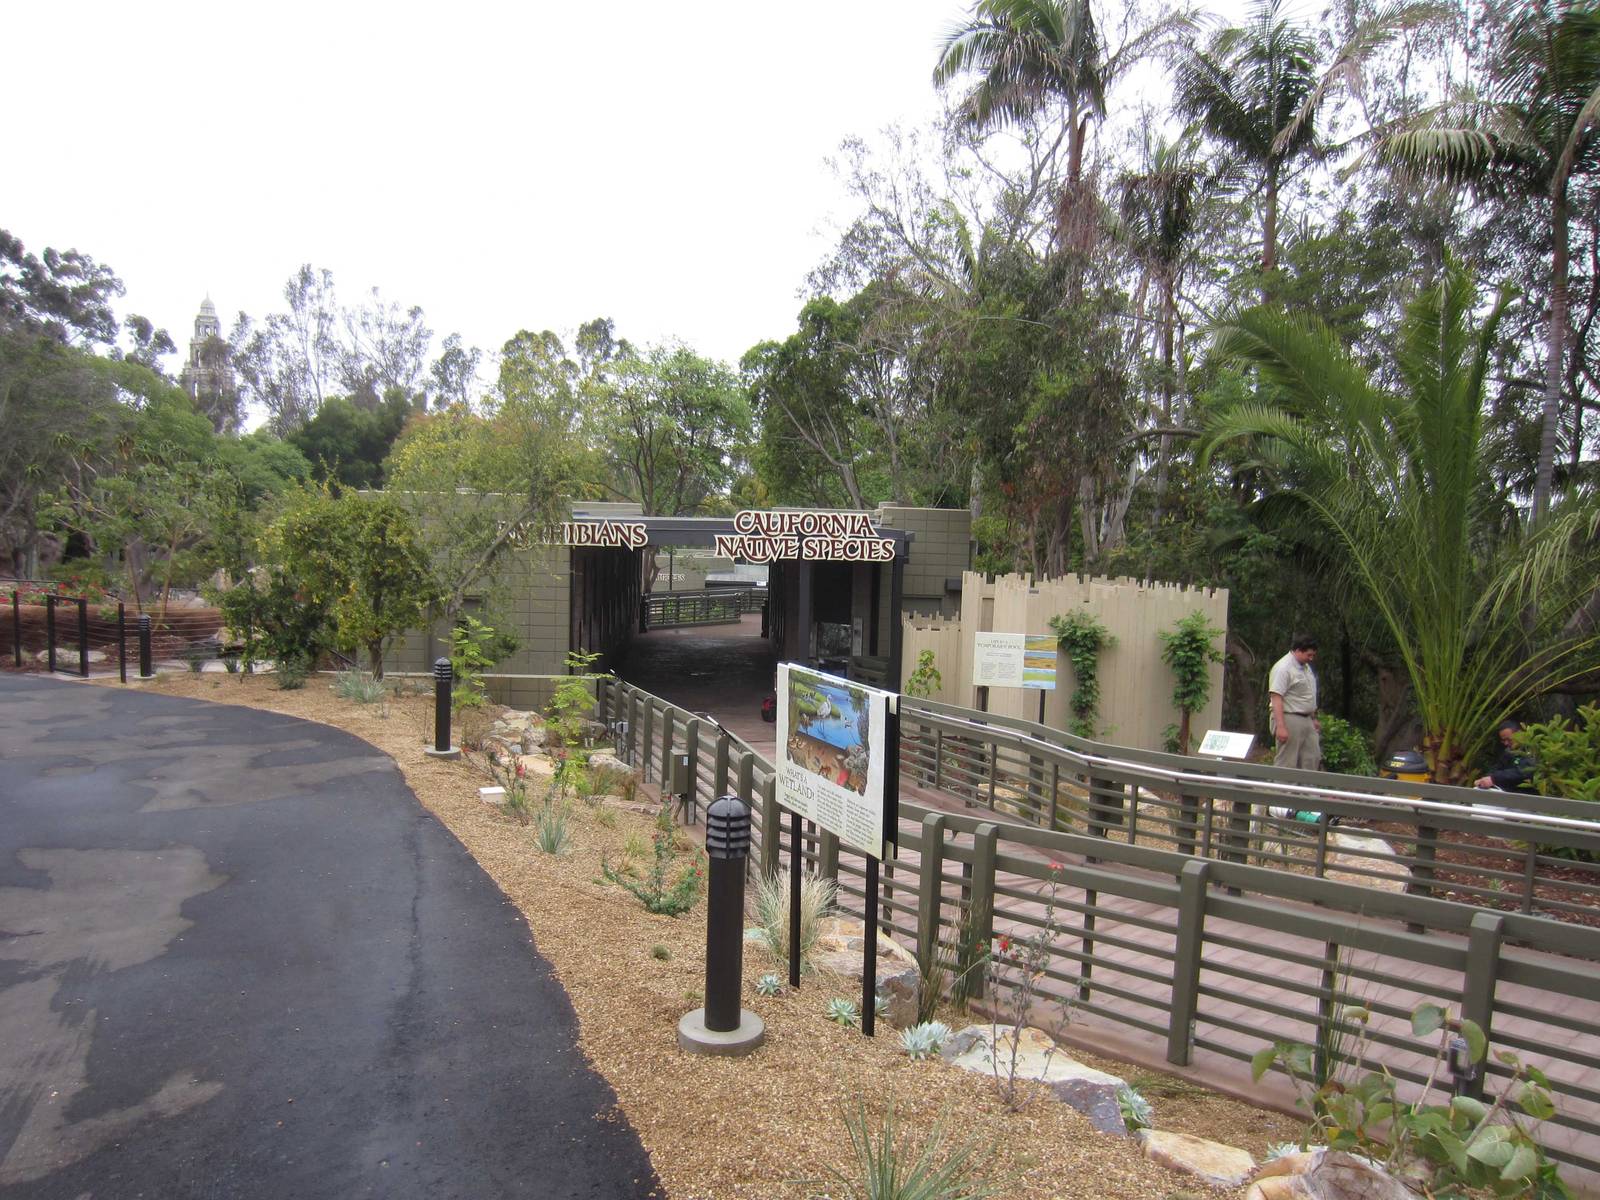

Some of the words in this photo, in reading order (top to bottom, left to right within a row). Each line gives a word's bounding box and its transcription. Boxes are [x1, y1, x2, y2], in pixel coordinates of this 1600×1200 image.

[734, 510, 880, 538] CALIFORNIA
[713, 535, 800, 563] NATIVE
[802, 537, 896, 563] SPECIES
